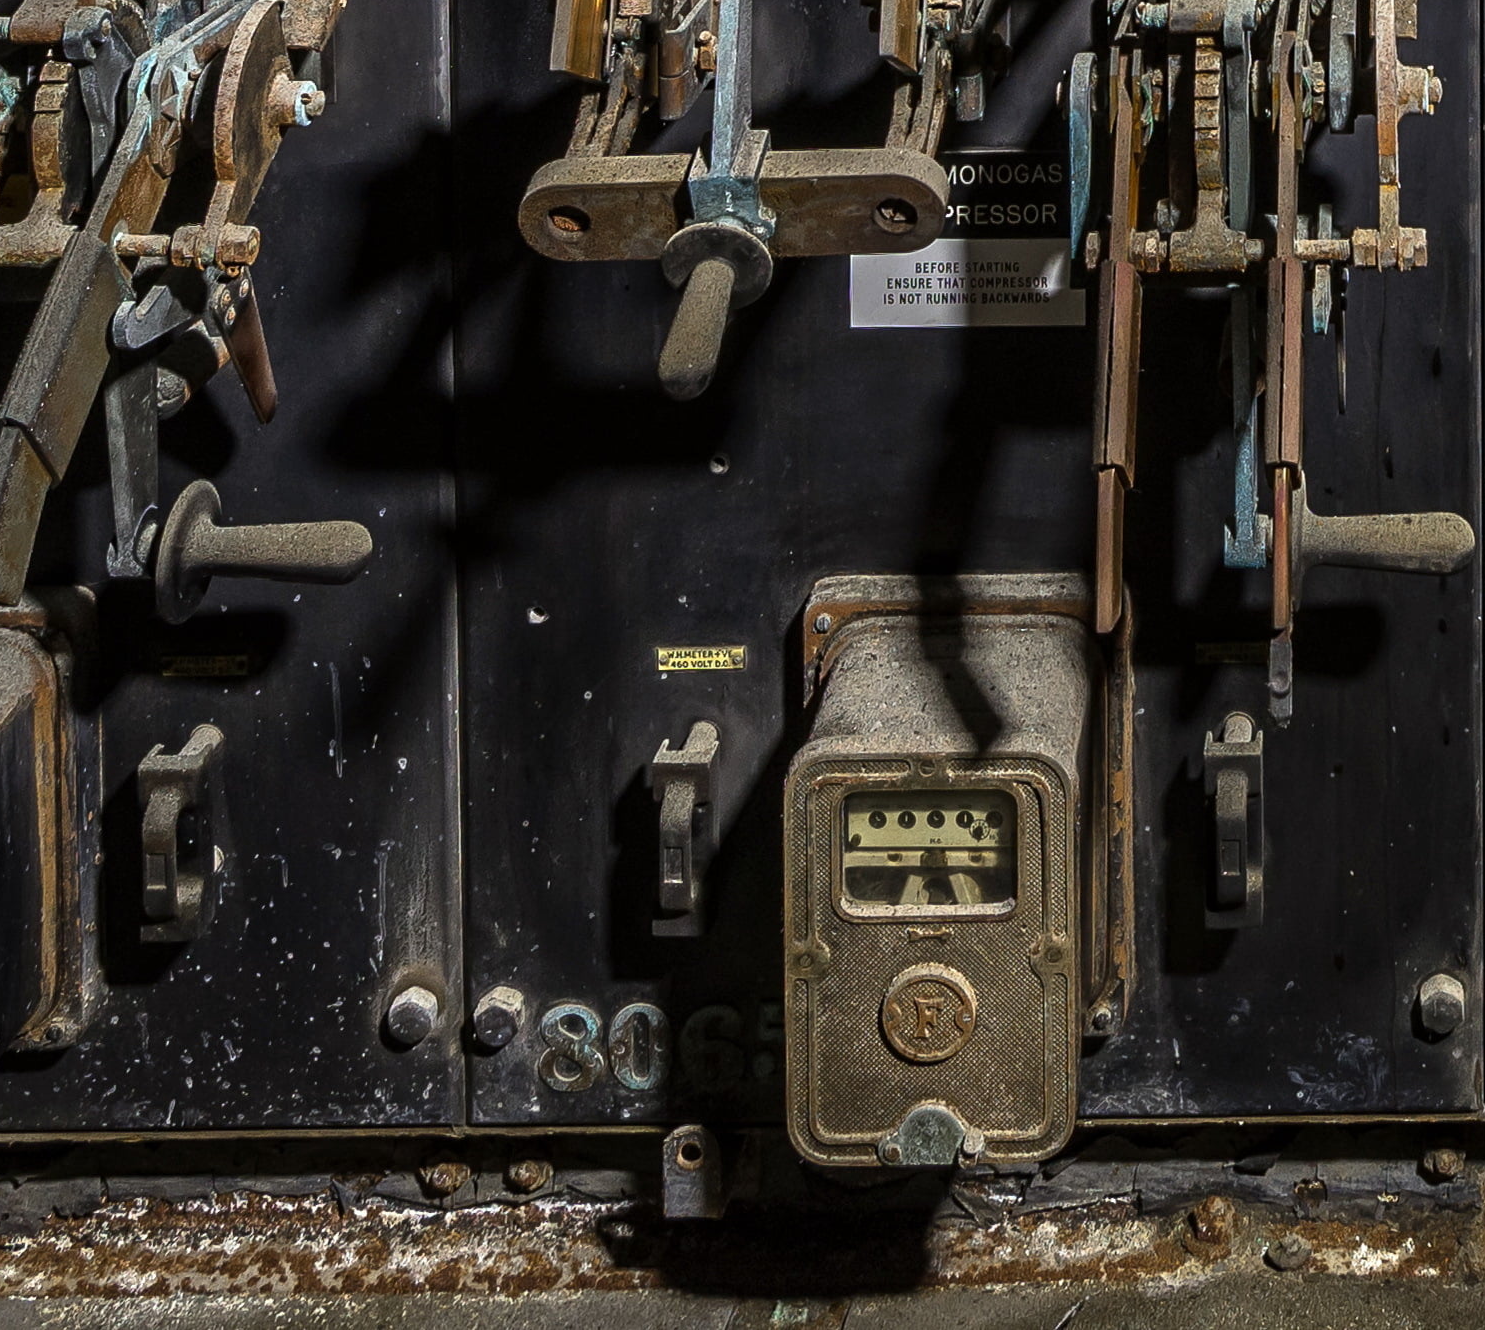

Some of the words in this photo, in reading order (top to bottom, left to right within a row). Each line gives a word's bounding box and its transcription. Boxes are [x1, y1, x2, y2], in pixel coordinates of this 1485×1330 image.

[947, 164, 1064, 186] MONOGAS
[944, 203, 1058, 226] PRESSOR
[915, 261, 960, 274] BEFORE
[965, 261, 1020, 274] STARTING
[886, 277, 932, 290] ENSURE
[937, 277, 966, 289] THAT
[970, 276, 1048, 289] COMPRESSOR
[883, 293, 895, 305] IS
[899, 293, 922, 305] NOT
[926, 293, 976, 305] RUNNING
[981, 292, 1051, 305] BACKWARDS
[670, 660, 689, 668] 460
[690, 660, 713, 668] VOLT
[913, 995, 945, 1039] F
